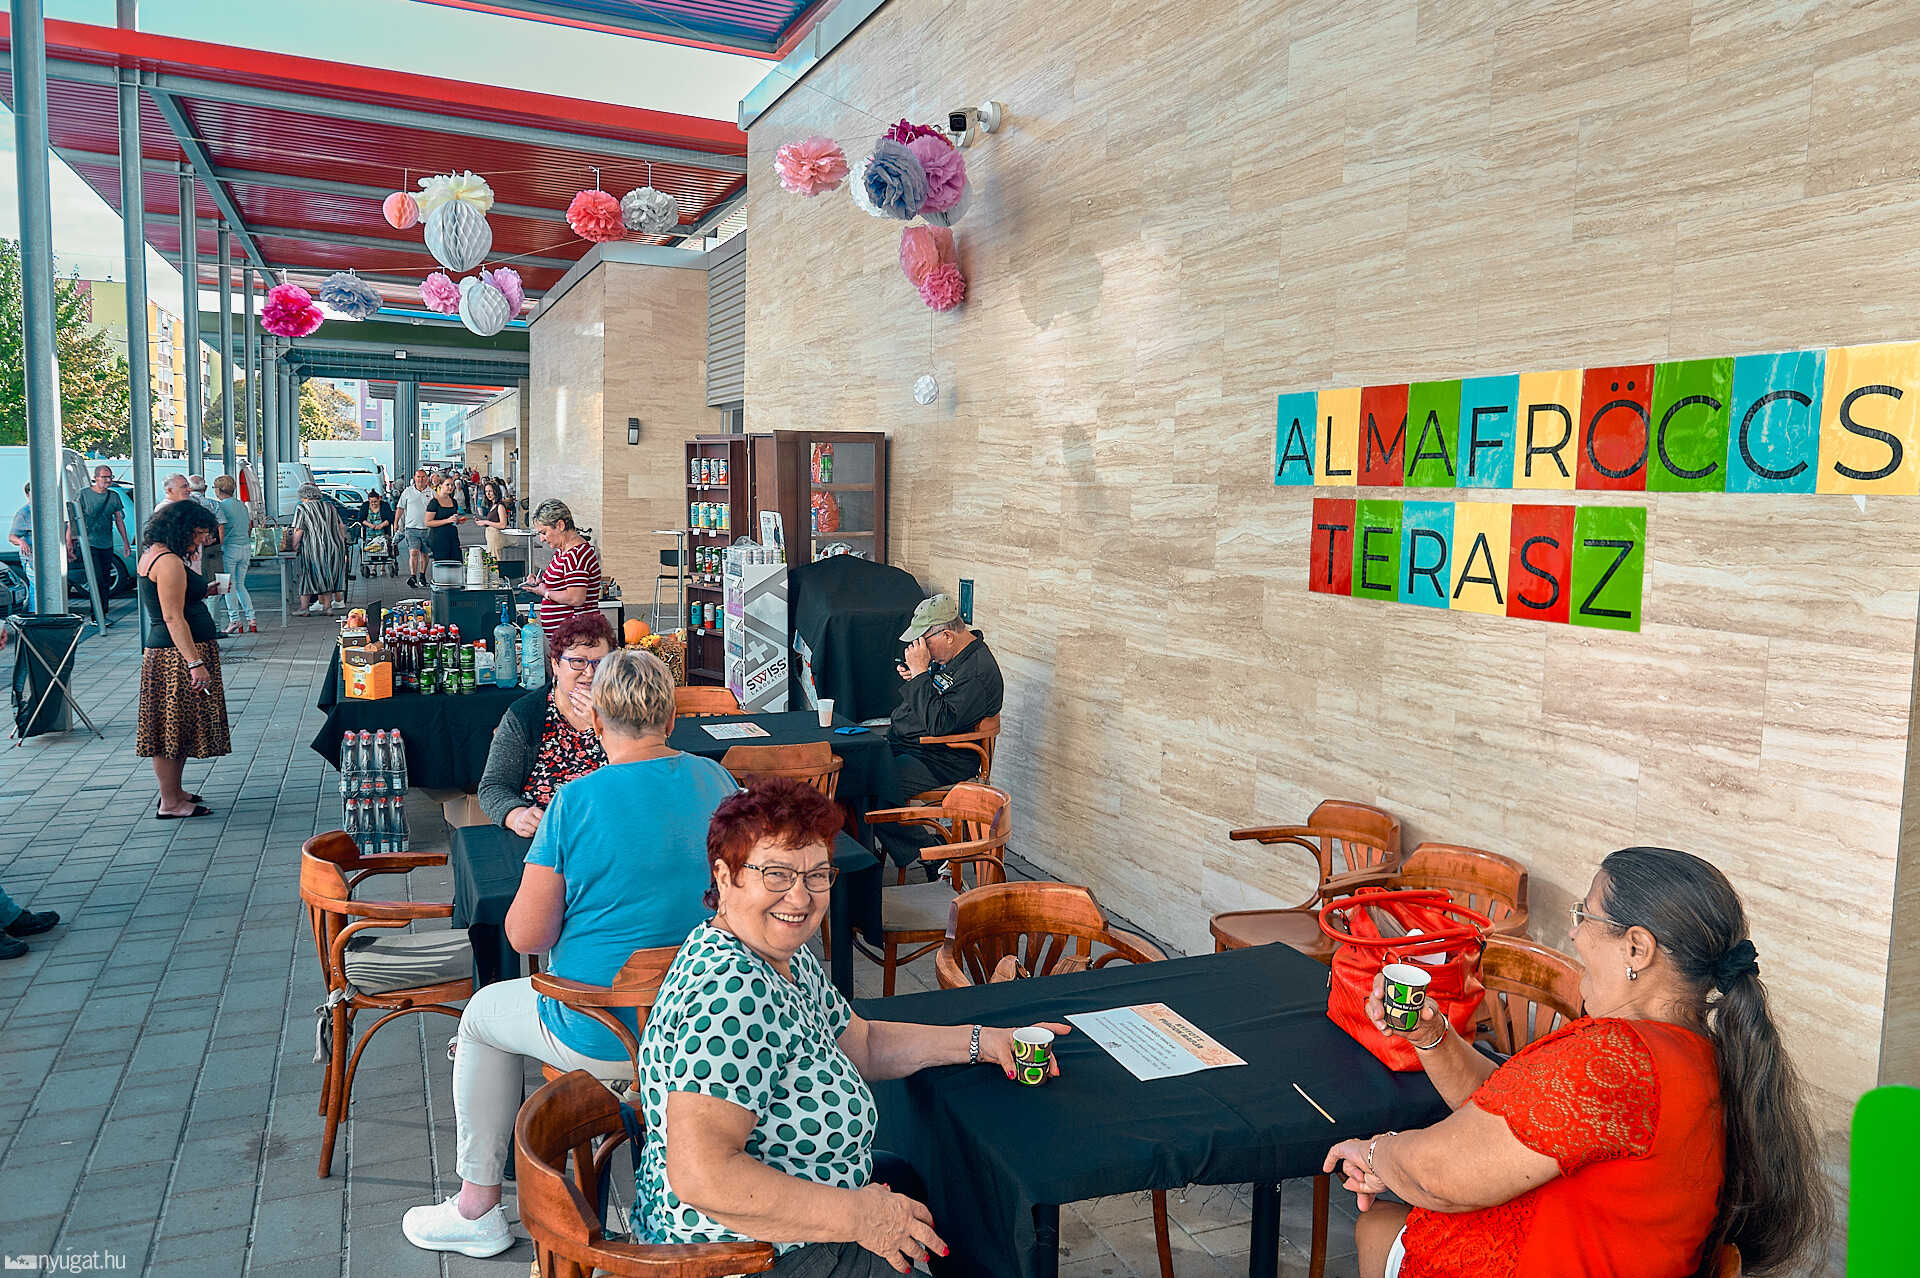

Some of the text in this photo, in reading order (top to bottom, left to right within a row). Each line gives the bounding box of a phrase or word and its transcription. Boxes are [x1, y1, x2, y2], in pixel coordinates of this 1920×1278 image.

[1277, 380, 1904, 481] ALMAFRÖCCS
[1317, 523, 1635, 619] TERASZ
[746, 659, 787, 691] SWISS
